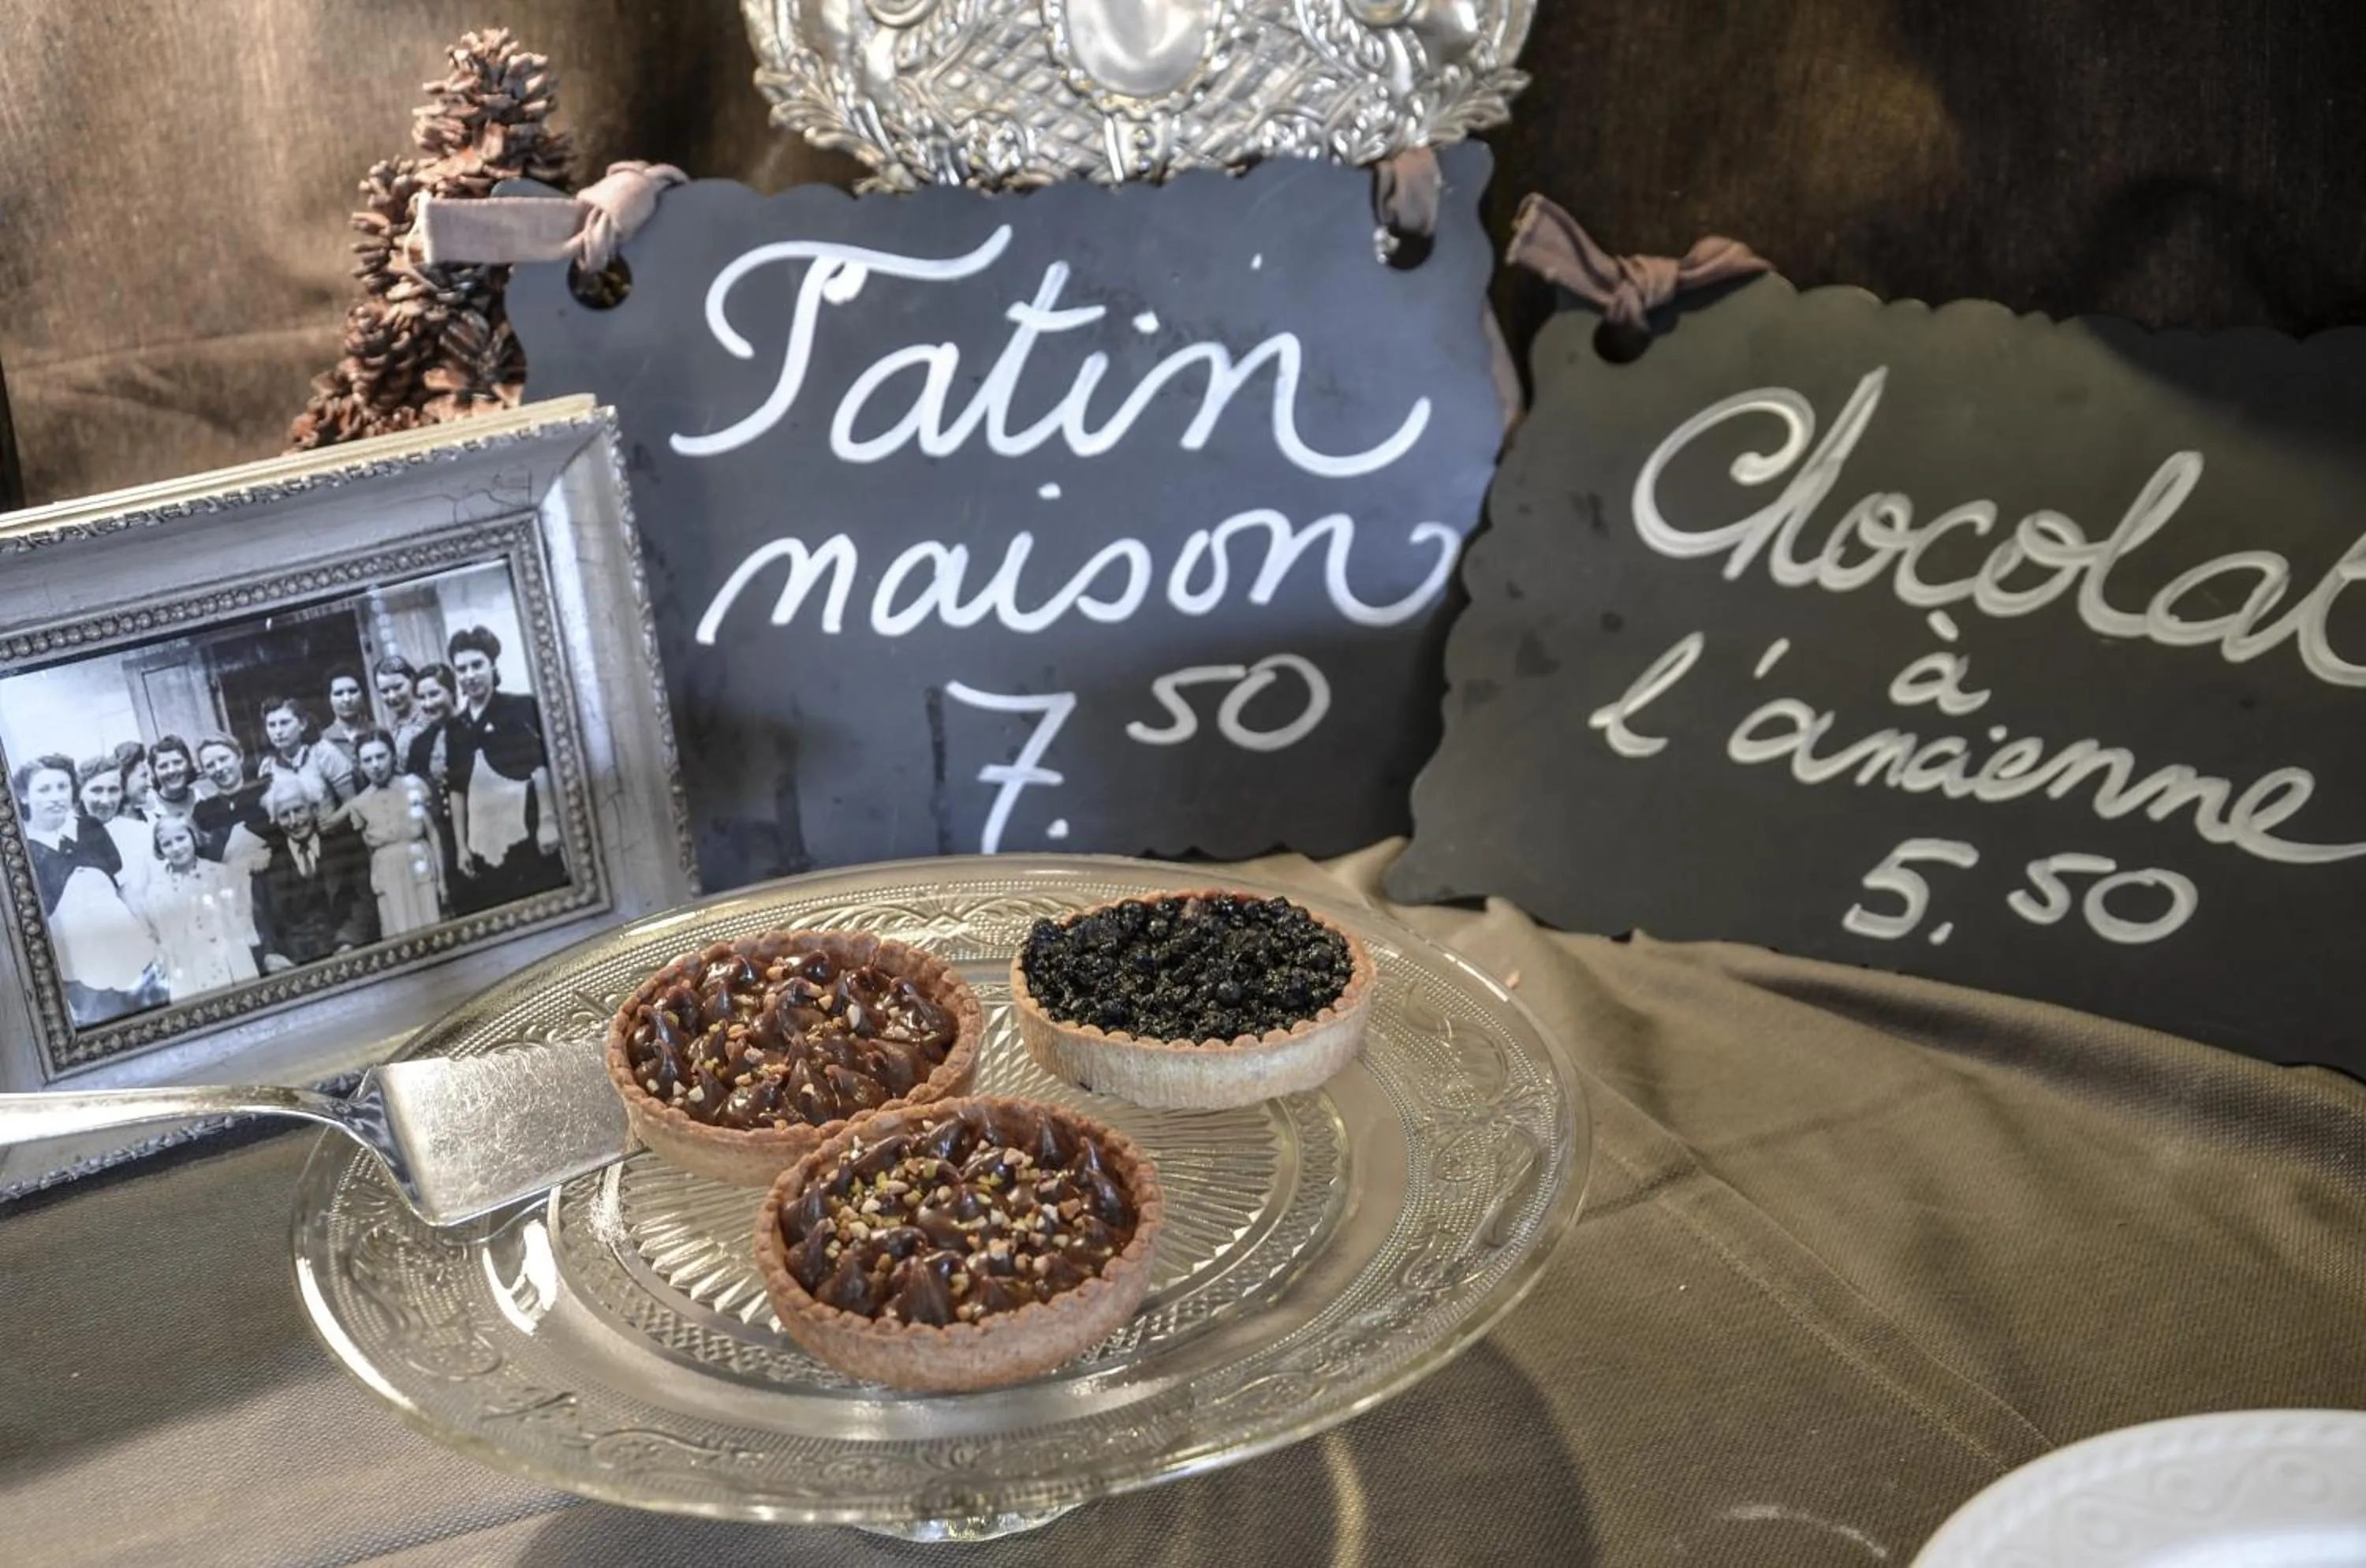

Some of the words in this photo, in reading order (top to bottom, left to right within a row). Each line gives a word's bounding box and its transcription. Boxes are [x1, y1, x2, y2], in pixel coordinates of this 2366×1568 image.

[670, 224, 1431, 477] Tatin
[696, 483, 1463, 645] maison
[1890, 610, 1991, 713] à
